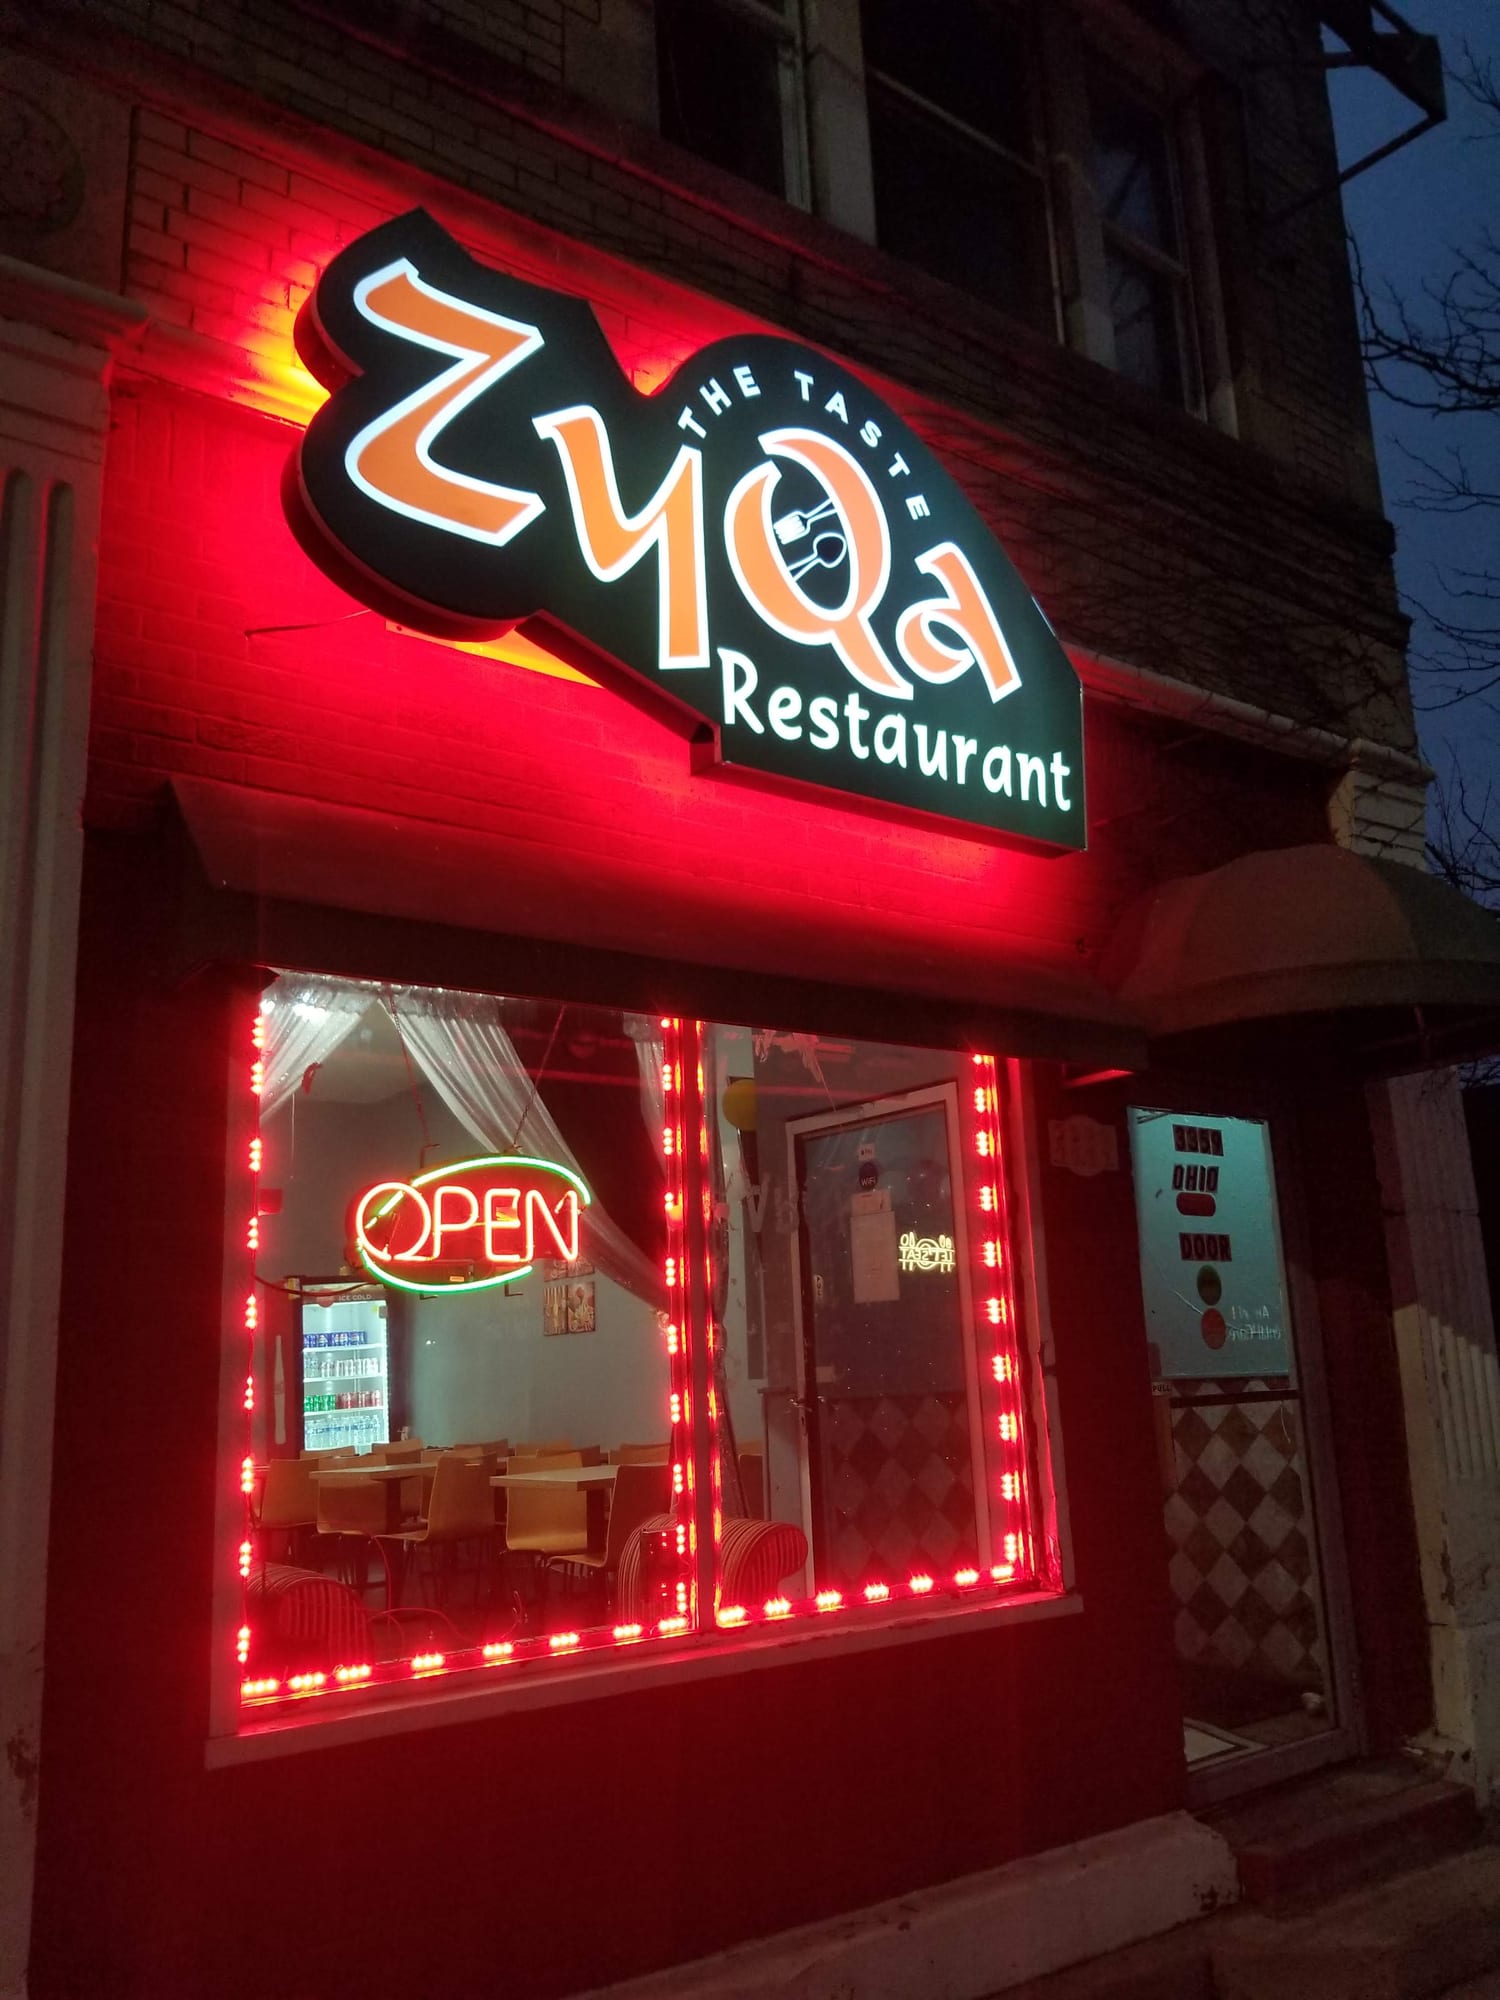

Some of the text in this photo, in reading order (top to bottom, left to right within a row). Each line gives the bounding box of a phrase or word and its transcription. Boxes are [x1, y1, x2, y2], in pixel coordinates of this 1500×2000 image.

[678, 364, 930, 522] THE TASTE
[717, 646, 1073, 812] Restaurant
[1173, 1164, 1219, 1193] OHIO
[355, 1181, 581, 1263] OPEN
[1180, 1234, 1231, 1260] DOOR
[1152, 1383, 1170, 1393] PULL
